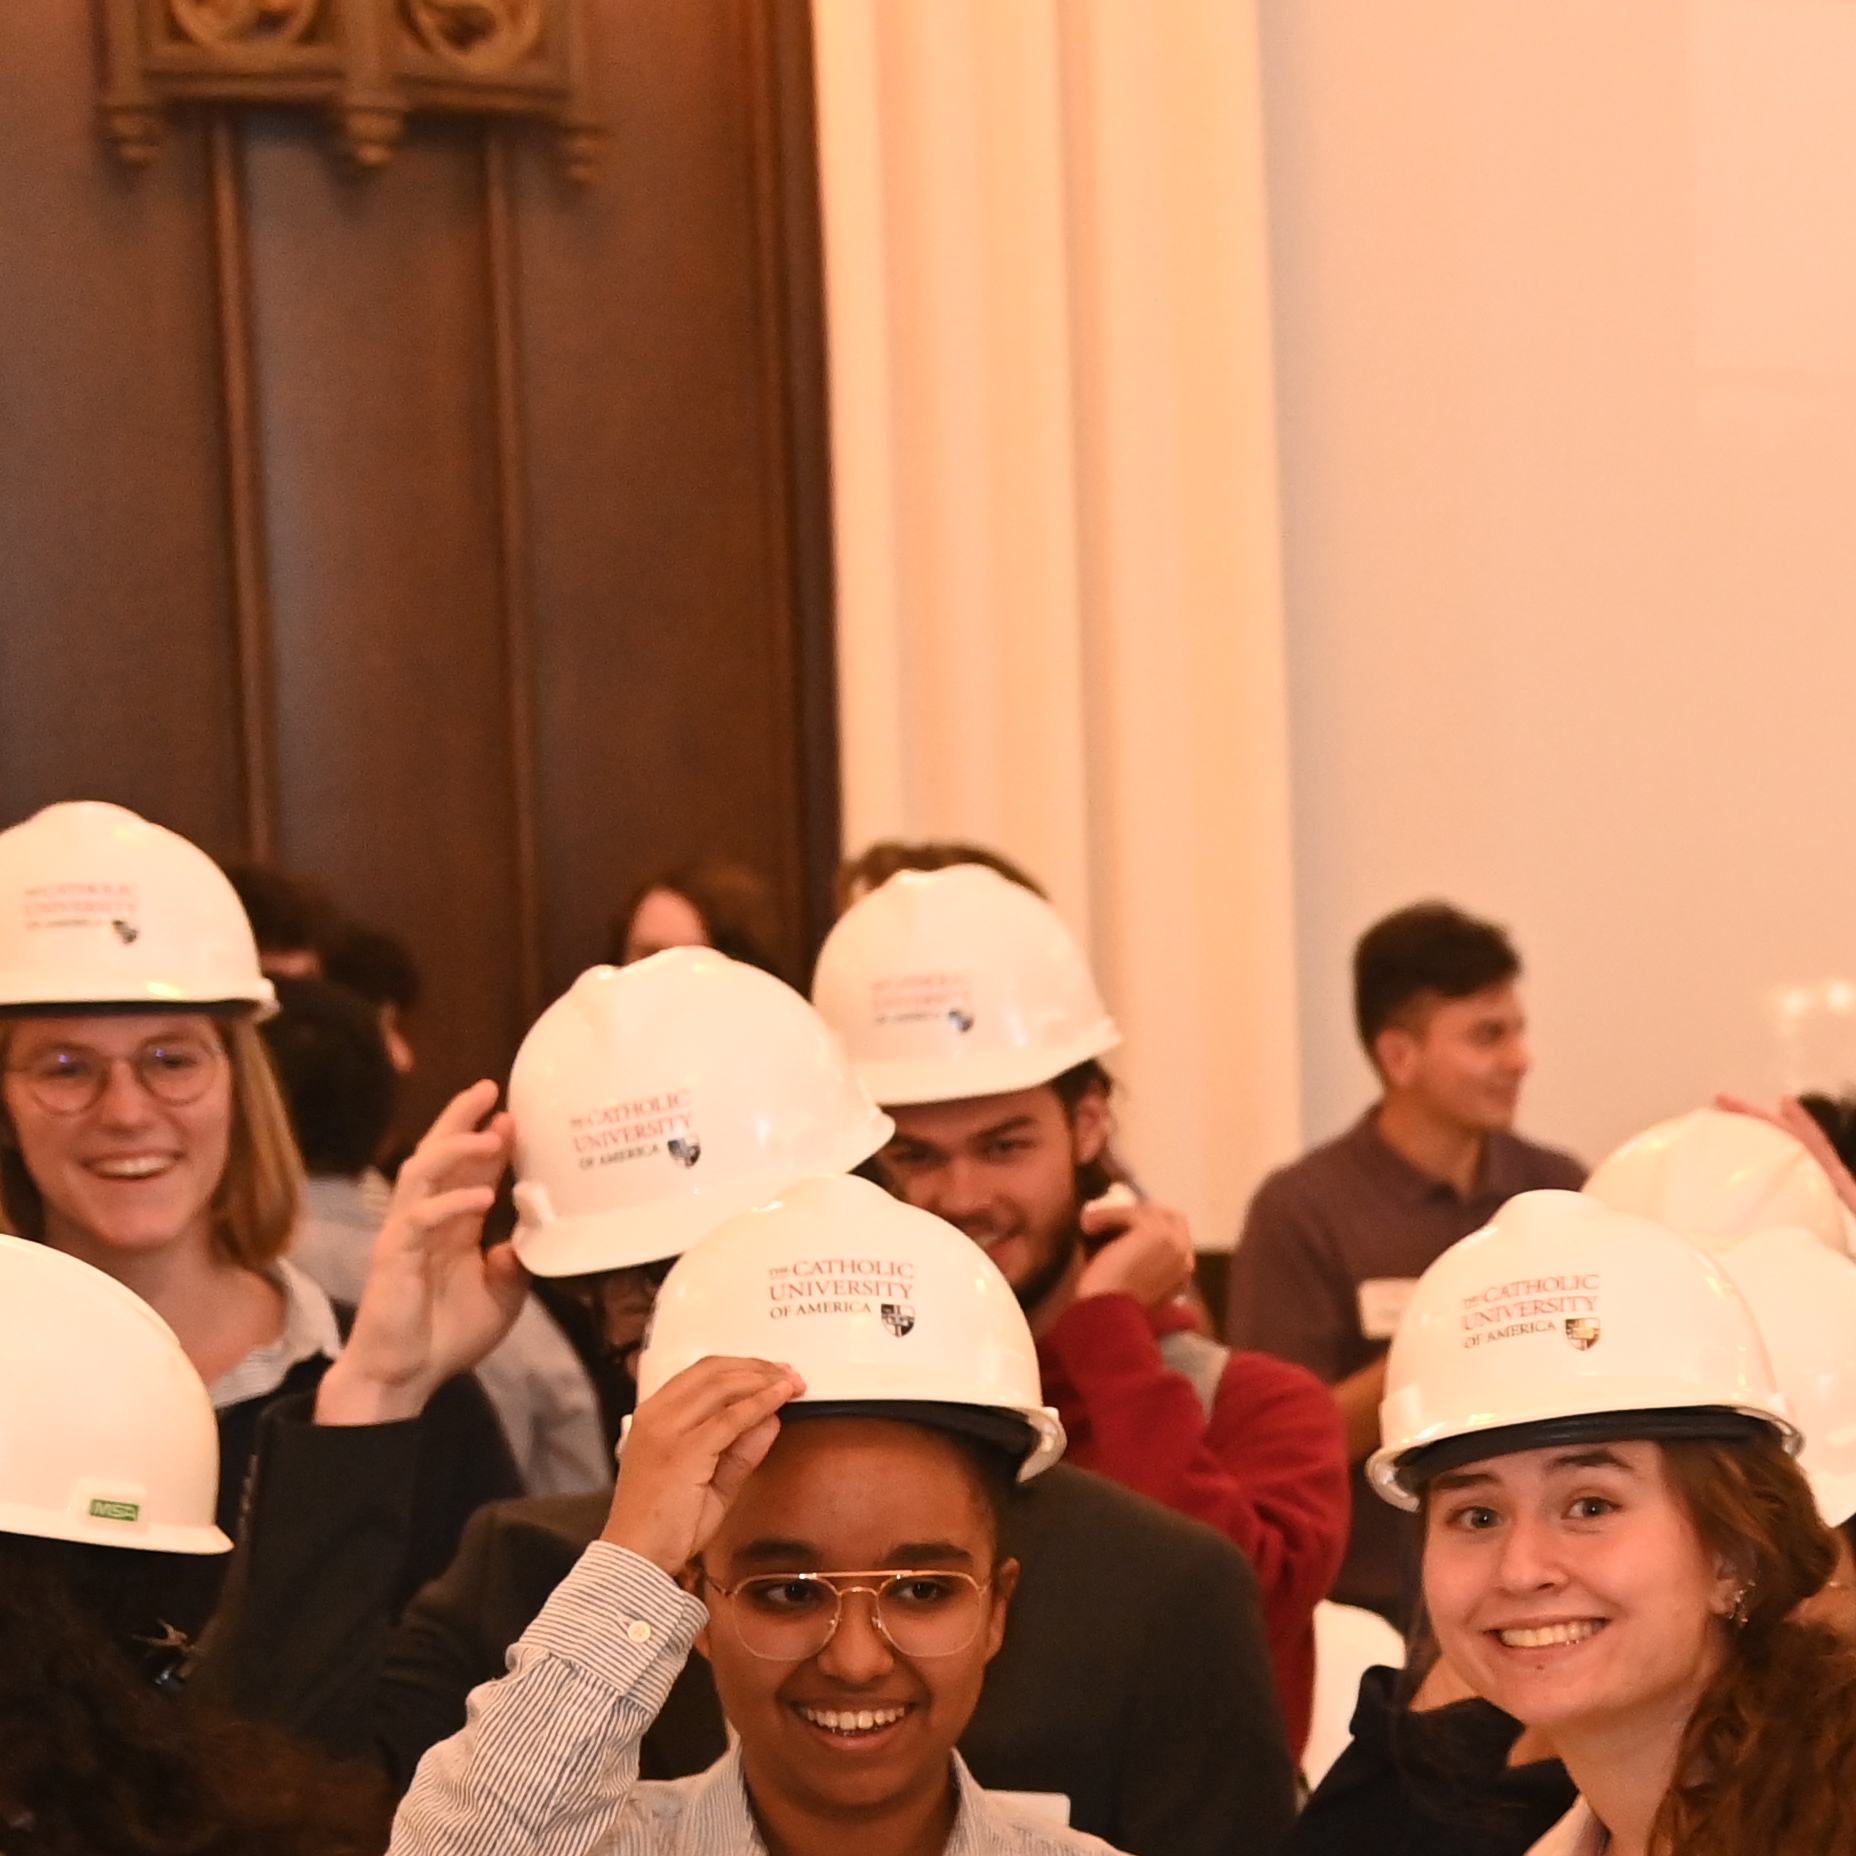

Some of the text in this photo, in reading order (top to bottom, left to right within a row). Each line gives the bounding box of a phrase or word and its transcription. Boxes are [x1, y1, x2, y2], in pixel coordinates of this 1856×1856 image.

[586, 1088, 691, 1126] CATHOLIC
[572, 1110, 693, 1153] UNIVERSITY
[792, 1258, 915, 1279] CATHOLIC
[769, 1279, 913, 1302] UNIVERSITY
[1483, 1273, 1600, 1303] CATHOLIC
[770, 1301, 872, 1320] OF AMERICA
[1461, 1294, 1598, 1331] UNIVERSITY
[1463, 1320, 1557, 1349] OF AMERICA
[94, 1501, 139, 1519] MSA
